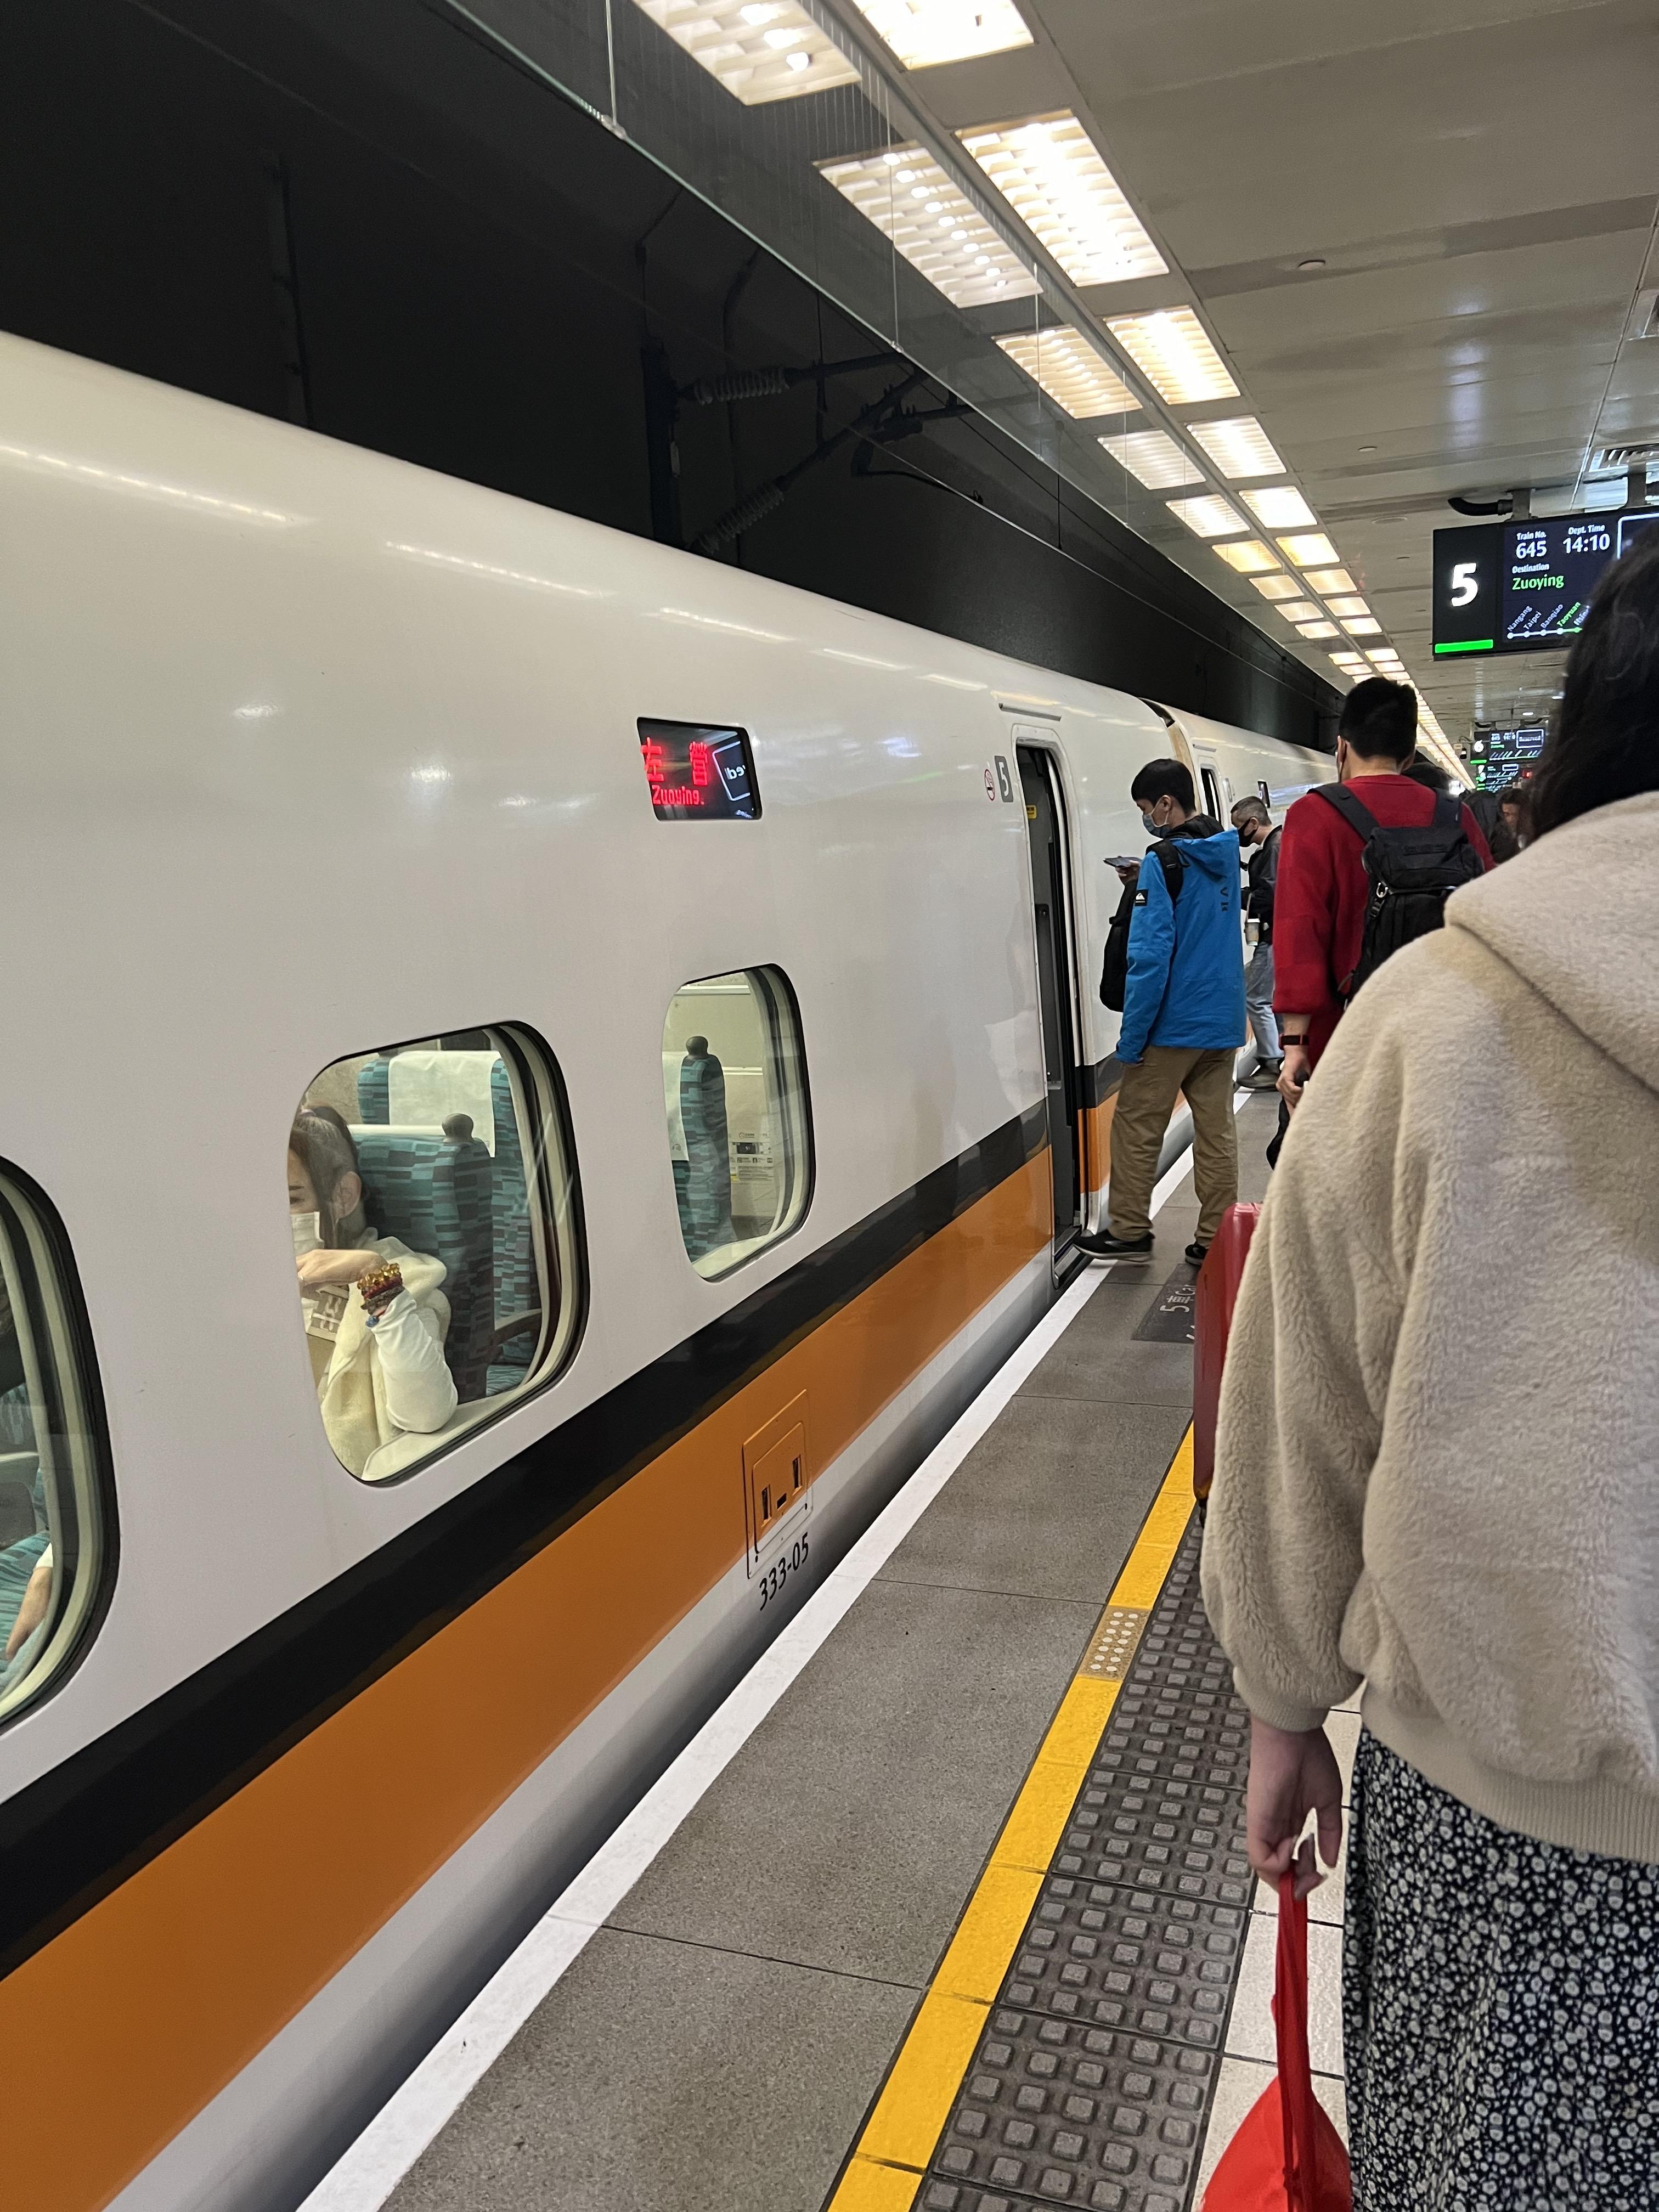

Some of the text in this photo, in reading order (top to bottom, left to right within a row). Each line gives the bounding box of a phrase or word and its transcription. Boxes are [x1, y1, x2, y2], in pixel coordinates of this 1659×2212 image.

[1516, 531, 1547, 540] Train No.
[1587, 524, 1605, 533] Time
[1516, 540, 1547, 559] 645
[1563, 534, 1610, 554] 14:10
[1512, 563, 1550, 574] Destination
[1451, 562, 1479, 607] 5
[1512, 574, 1564, 590] Zuoying
[1507, 606, 1533, 632] Nangang
[1523, 611, 1542, 630] Taipei
[1540, 604, 1564, 628] Banqiao
[1556, 602, 1581, 627] Taoyuan
[998, 761, 1009, 797] 5
[759, 1532, 809, 1611] 333-05
